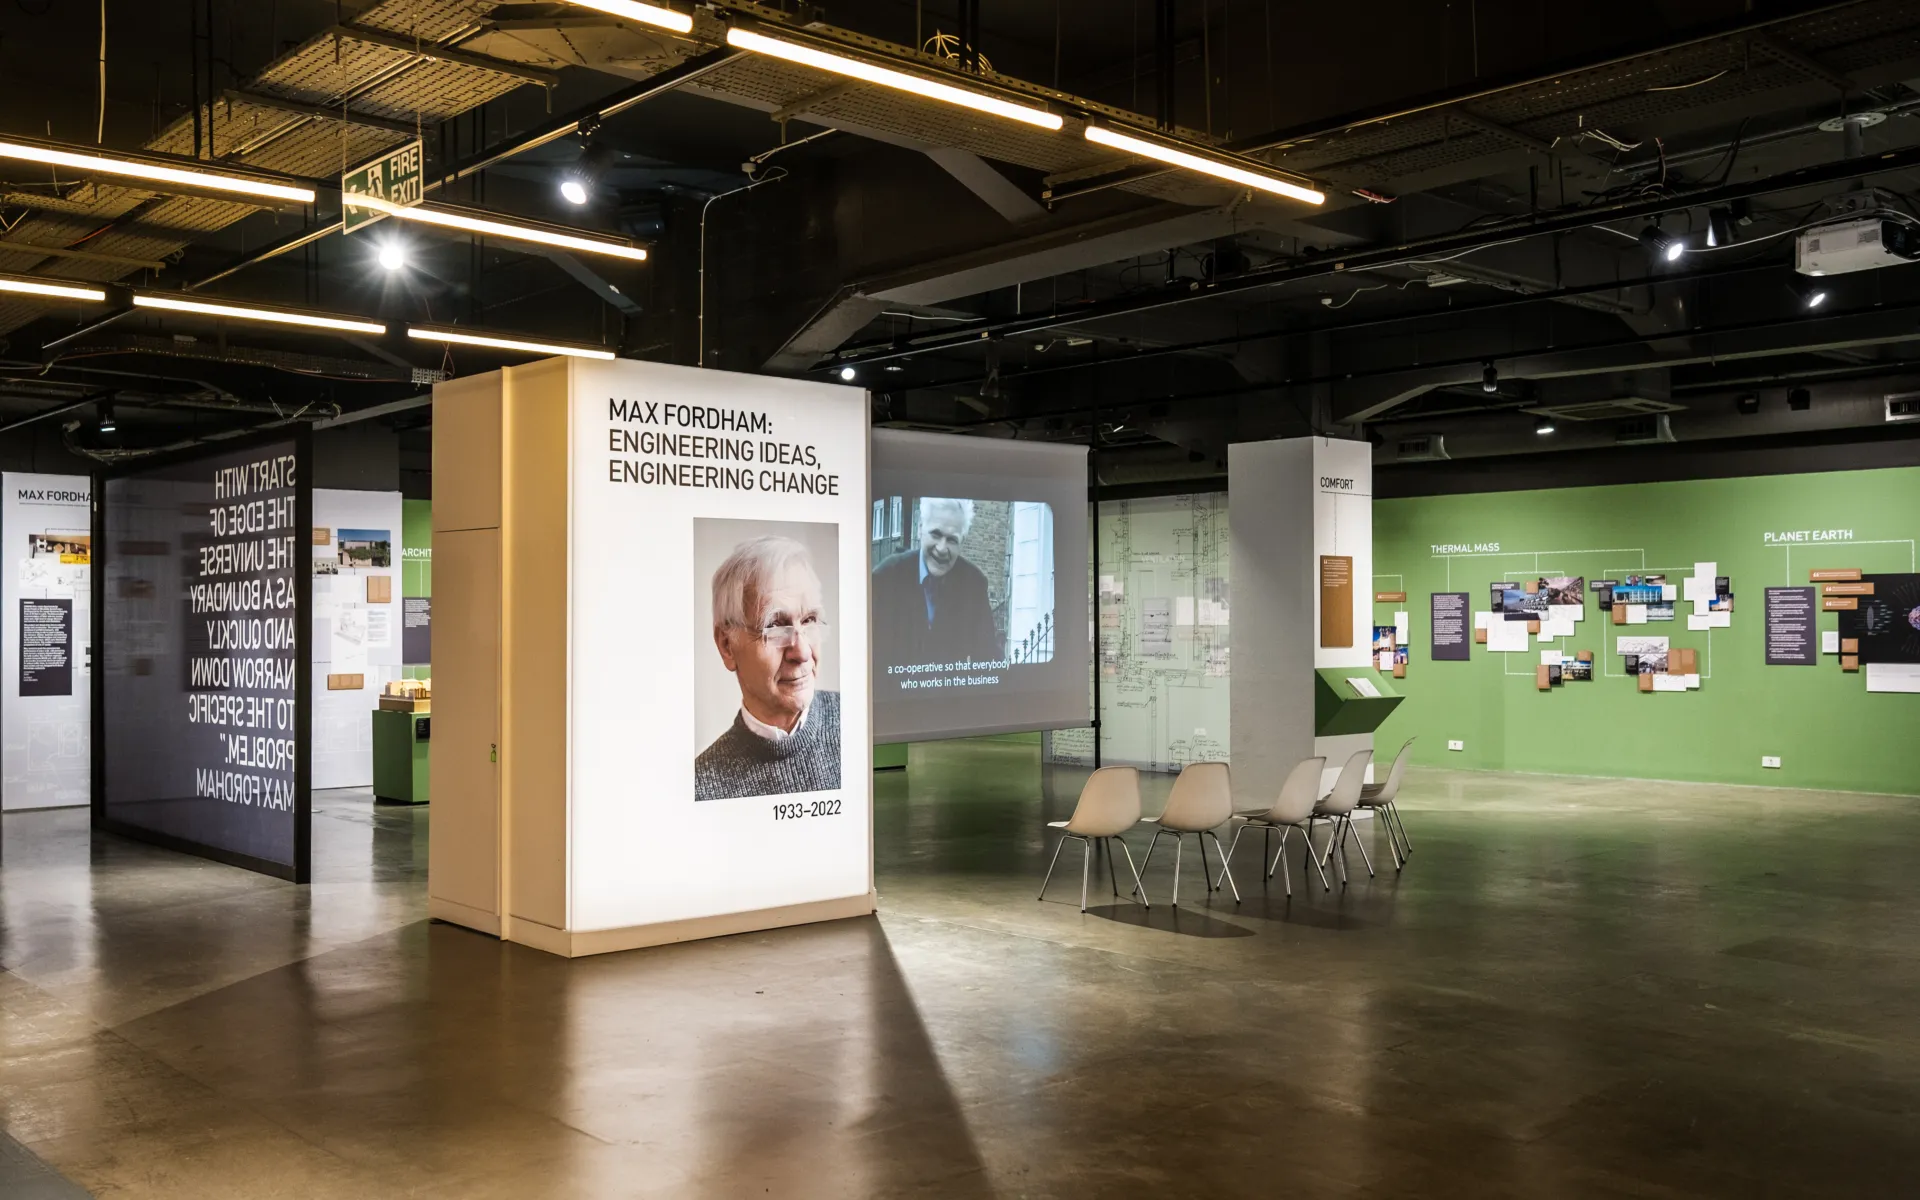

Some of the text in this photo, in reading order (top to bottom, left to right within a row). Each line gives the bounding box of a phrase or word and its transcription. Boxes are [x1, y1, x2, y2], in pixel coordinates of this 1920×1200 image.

[390, 147, 418, 180] FIRE
[390, 176, 418, 204] EXIT
[609, 398, 773, 435] MAX FORDHAM:
[609, 428, 821, 470] ENGINEERING IDEAS,
[609, 459, 839, 496] ENGINEERING CHANGE
[1320, 476, 1354, 490] COMFORT
[18, 489, 45, 501] MAX
[1764, 529, 1853, 542] PLANET EARTH
[1431, 543, 1500, 554] THERMAL MASS
[887, 659, 1010, 675] a co-operative so that everybody
[900, 675, 999, 689] who works in the business
[773, 799, 842, 820] 1933–2022
